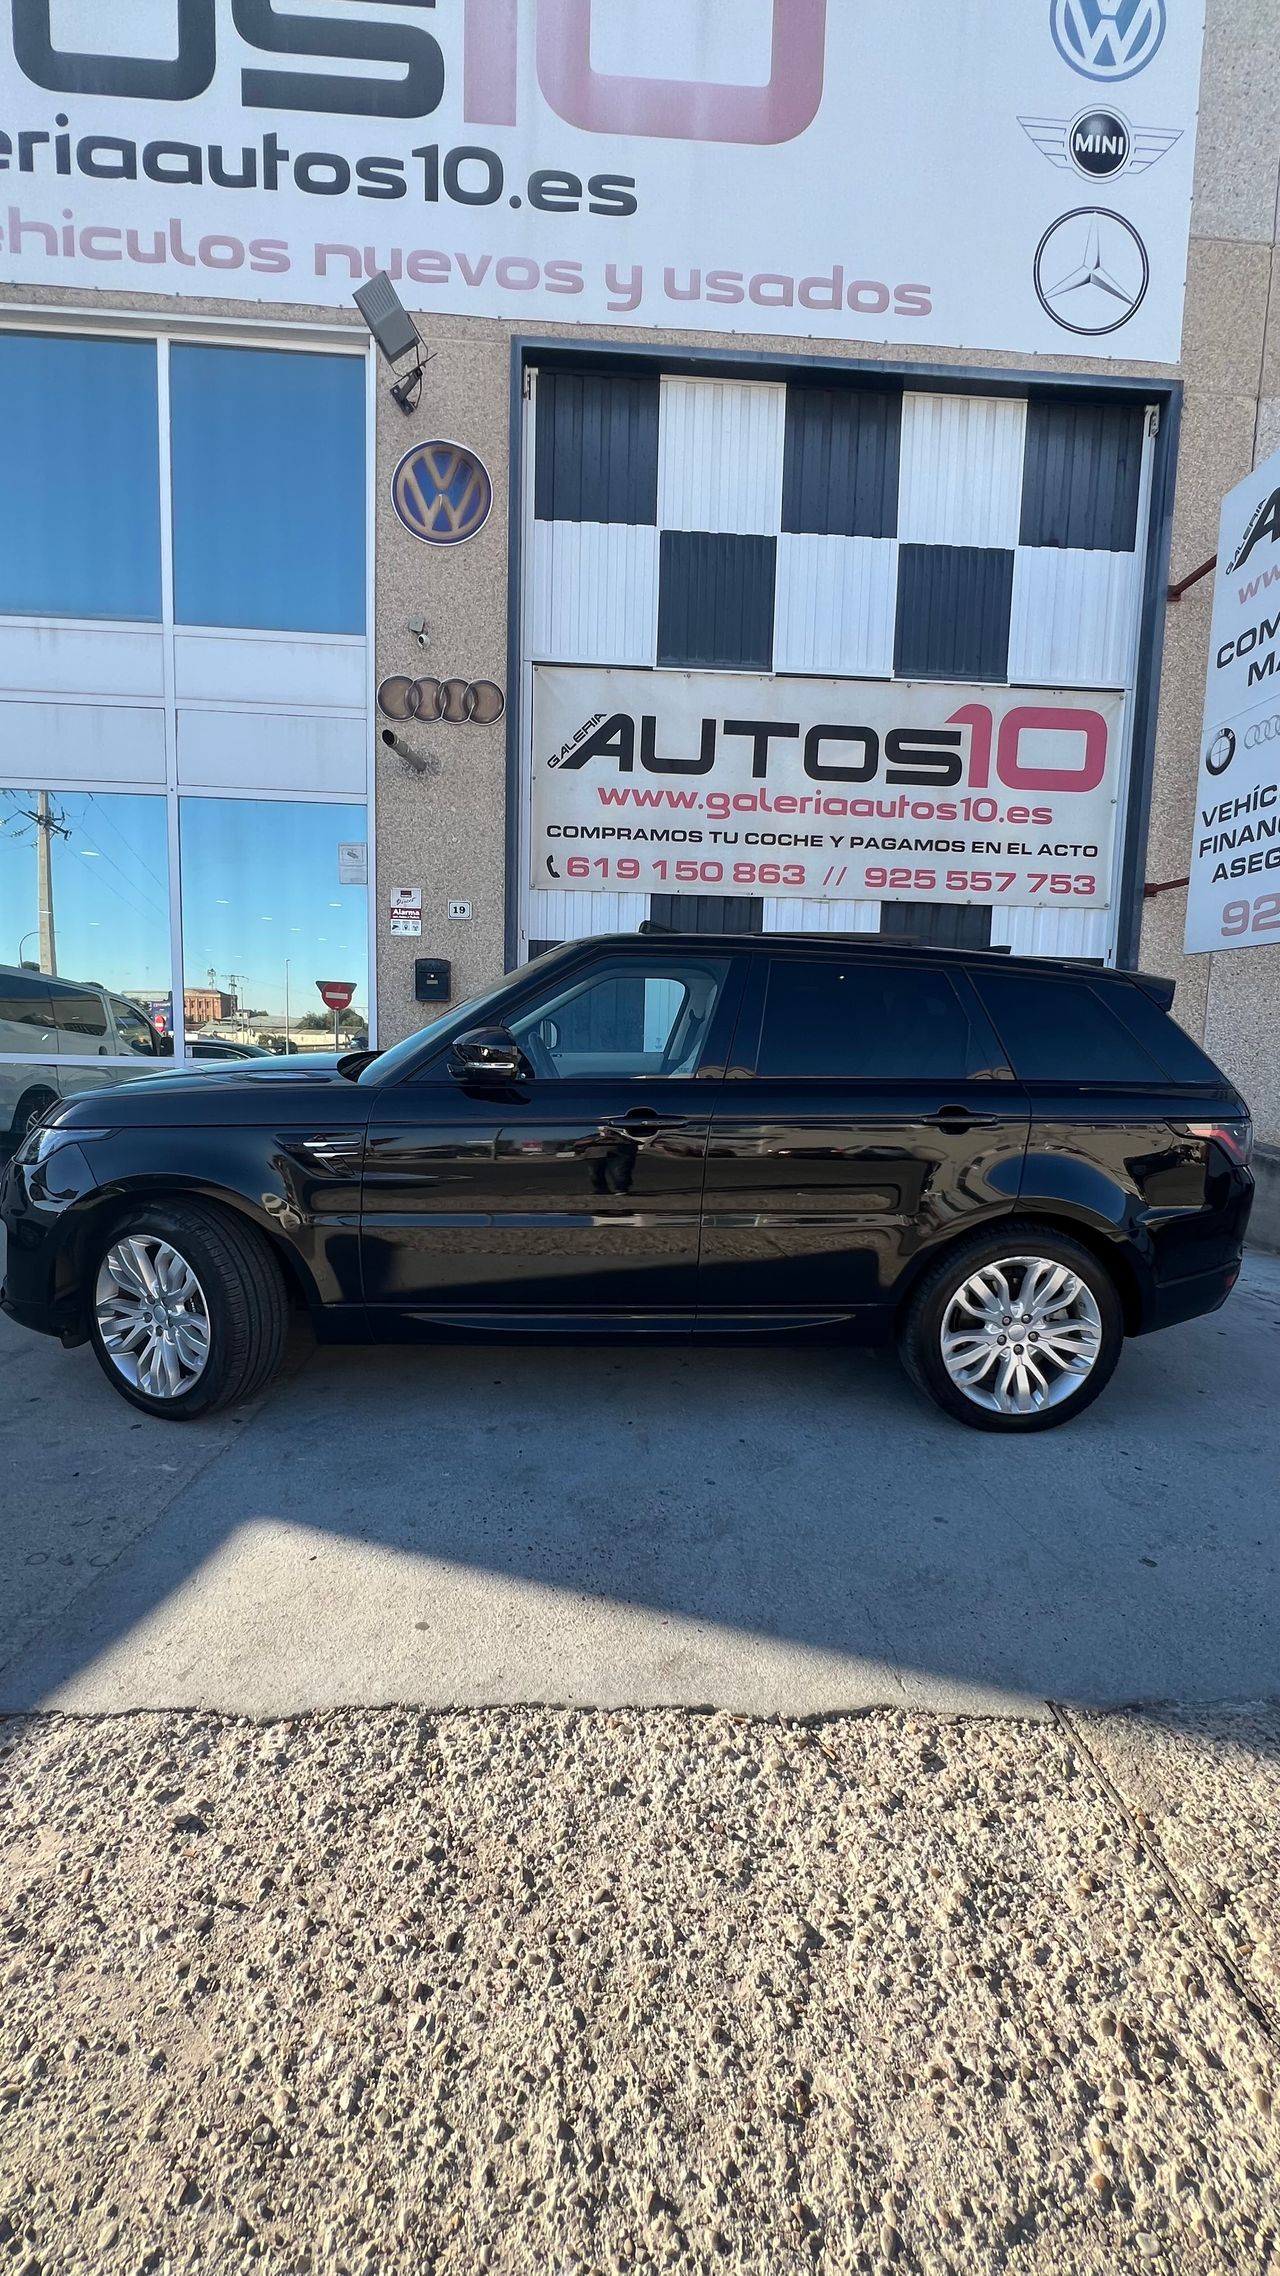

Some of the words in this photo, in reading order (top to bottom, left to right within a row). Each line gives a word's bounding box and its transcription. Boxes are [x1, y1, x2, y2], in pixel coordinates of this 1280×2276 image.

[1075, 132, 1124, 155] MINI
[0, 112, 638, 216] riaautos10.es
[0, 206, 291, 273] hiculos
[314, 242, 585, 295] nuevos
[605, 264, 642, 311] y
[663, 264, 933, 317] usados
[1247, 650, 1280, 687] M
[547, 713, 608, 769] GALERIA
[557, 702, 1109, 793] AUTOS10
[597, 786, 1054, 826] www.galeriaautos10.es
[546, 824, 703, 843] COMPRAMOS
[709, 831, 738, 844] TU
[744, 832, 824, 847] COCHE
[829, 836, 845, 848] Y
[850, 836, 965, 854] PAGAMOS
[971, 842, 1001, 855] EN
[1007, 843, 1032, 856] EL
[1037, 844, 1099, 858] ACTO
[566, 856, 641, 880] 619
[651, 859, 724, 883] 150
[732, 862, 806, 885] 863
[864, 867, 937, 890] 925
[945, 870, 1017, 892] 557
[1027, 873, 1096, 895] 753
[392, 908, 420, 916] Alarma
